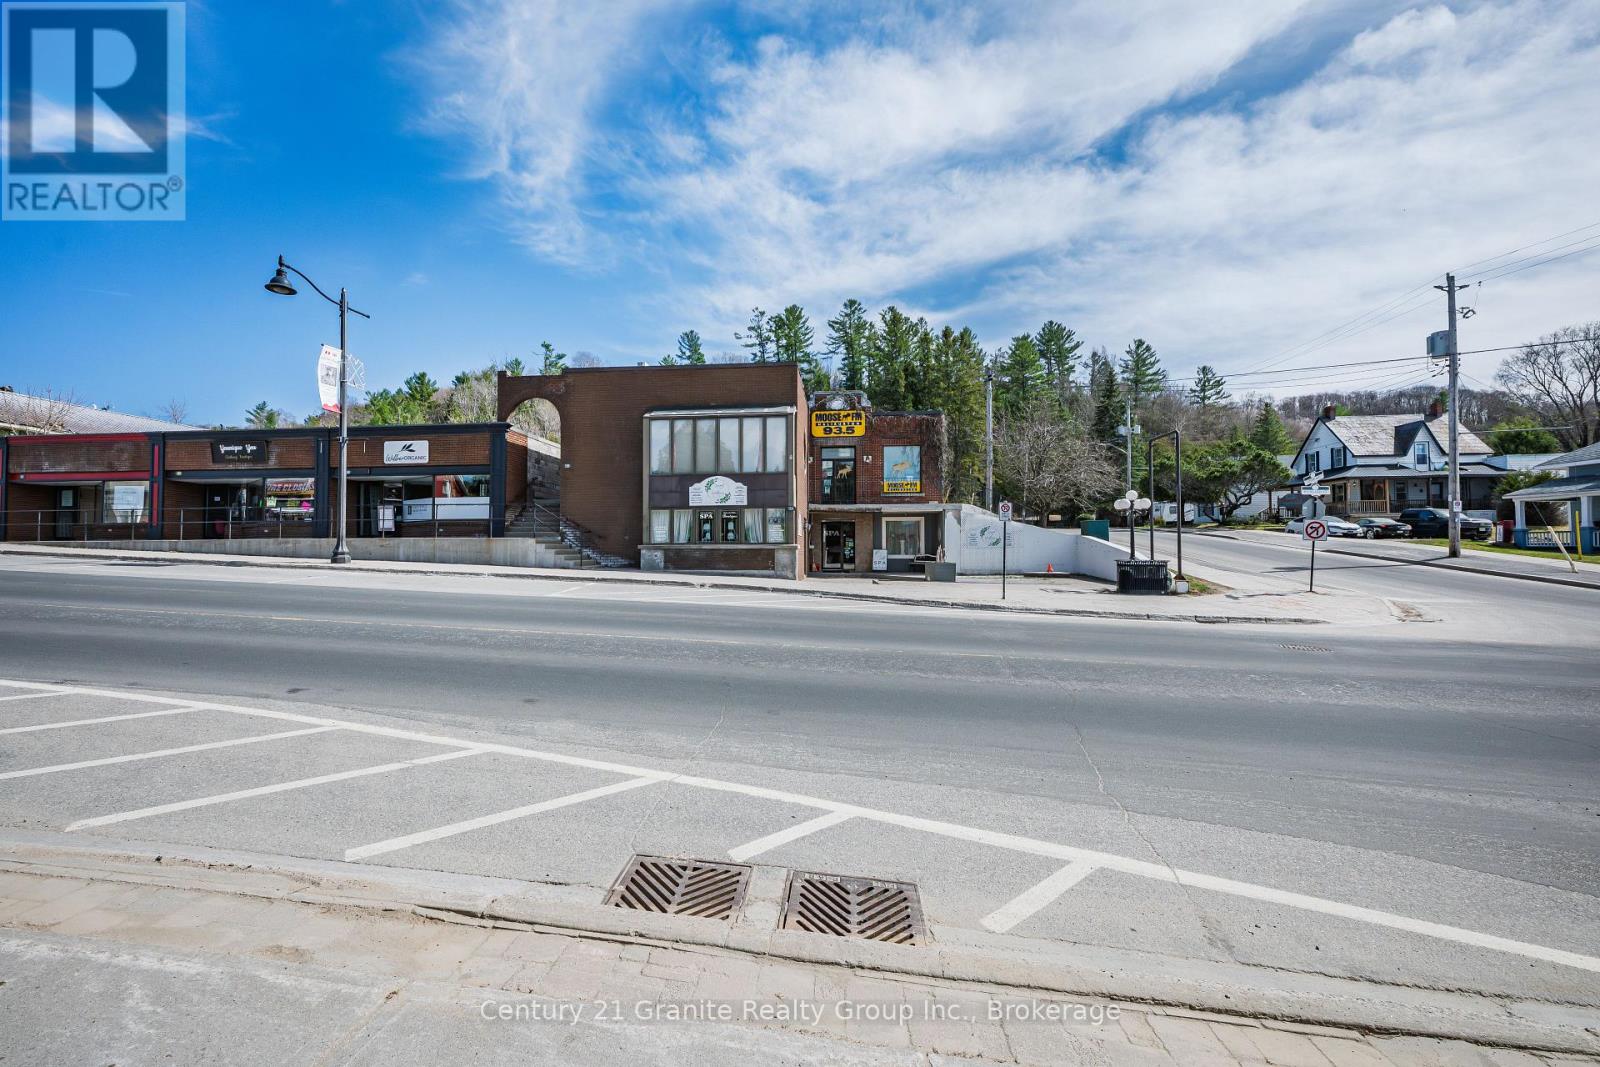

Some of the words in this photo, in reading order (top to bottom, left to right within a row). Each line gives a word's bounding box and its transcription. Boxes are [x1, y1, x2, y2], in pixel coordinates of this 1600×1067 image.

[815, 412, 842, 421] MOOSE
[851, 411, 862, 421] FM
[823, 426, 856, 435] 93.5
